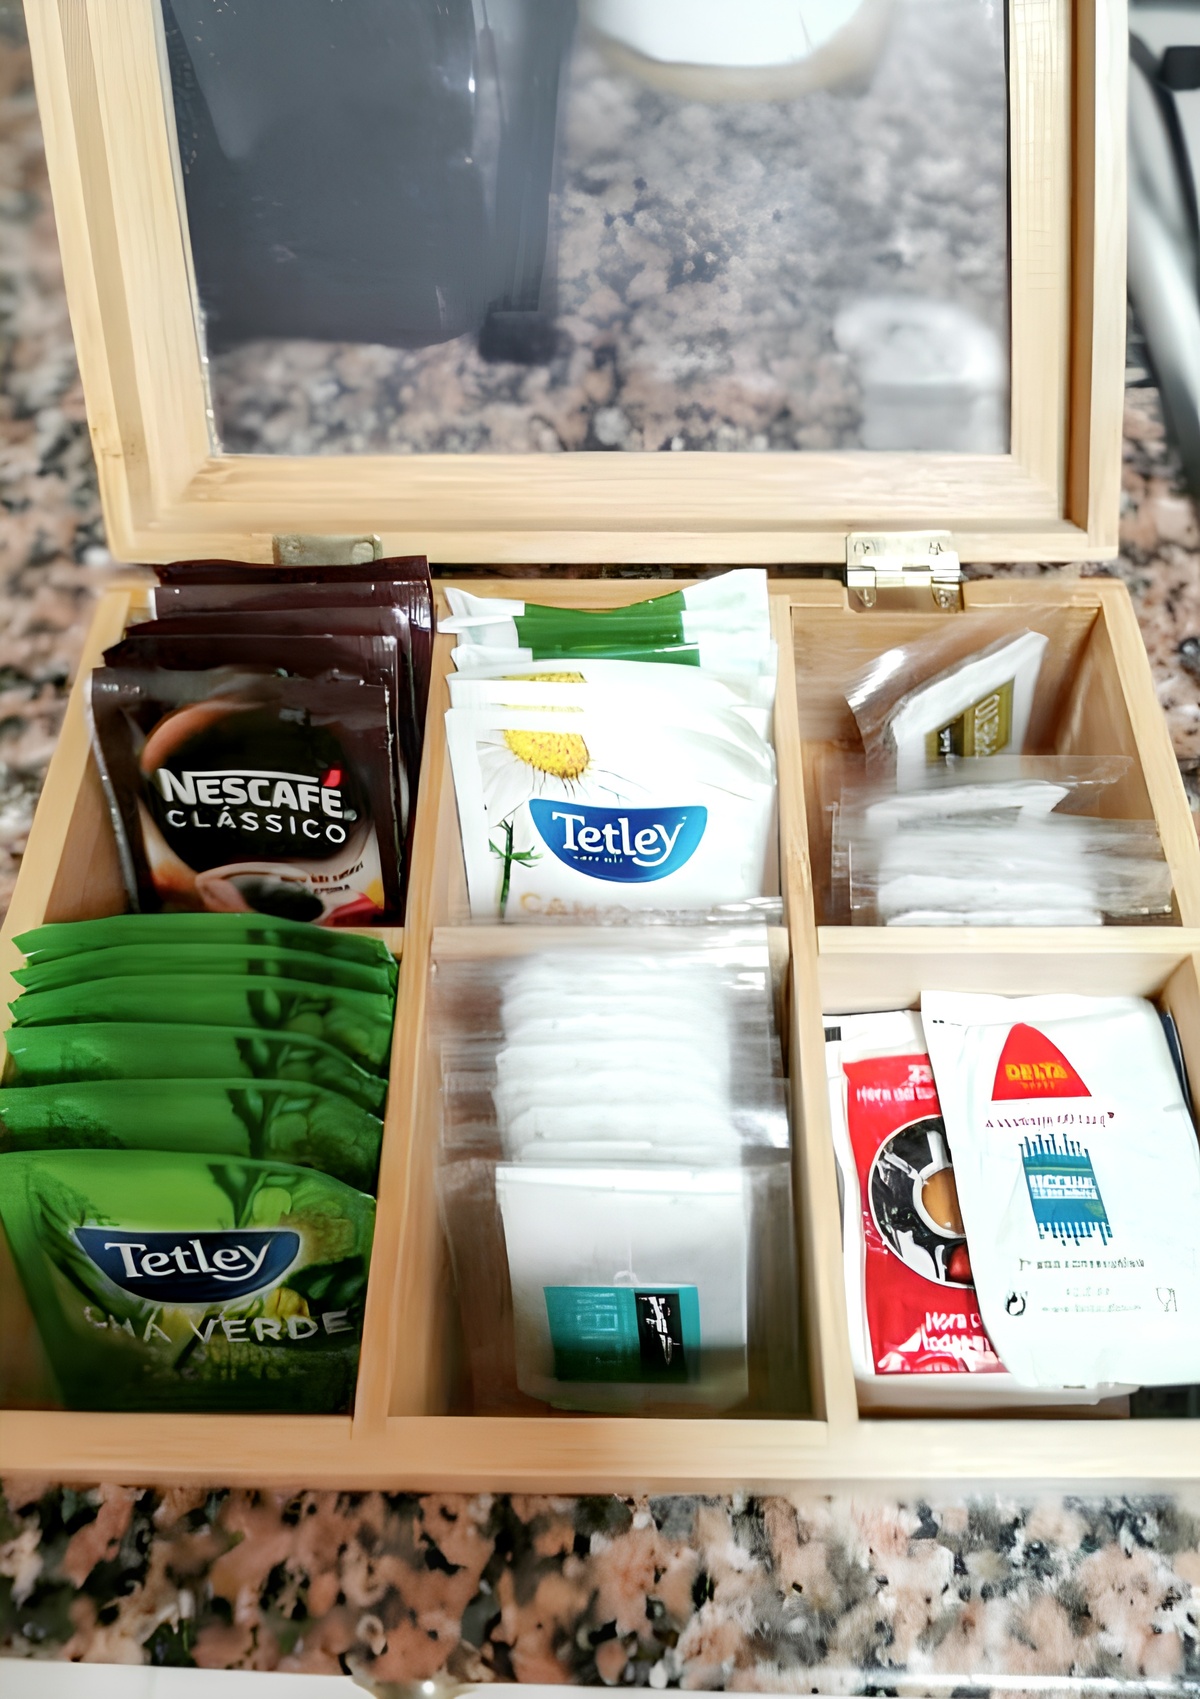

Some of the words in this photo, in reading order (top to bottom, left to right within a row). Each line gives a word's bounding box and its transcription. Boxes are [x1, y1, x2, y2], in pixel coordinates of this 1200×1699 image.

[157, 768, 344, 819] NESCAFÉ
[166, 805, 347, 844] CLÁSSICO
[552, 811, 688, 868] Tetley
[104, 1239, 272, 1282] Tetley
[189, 1306, 354, 1344] VERDE
